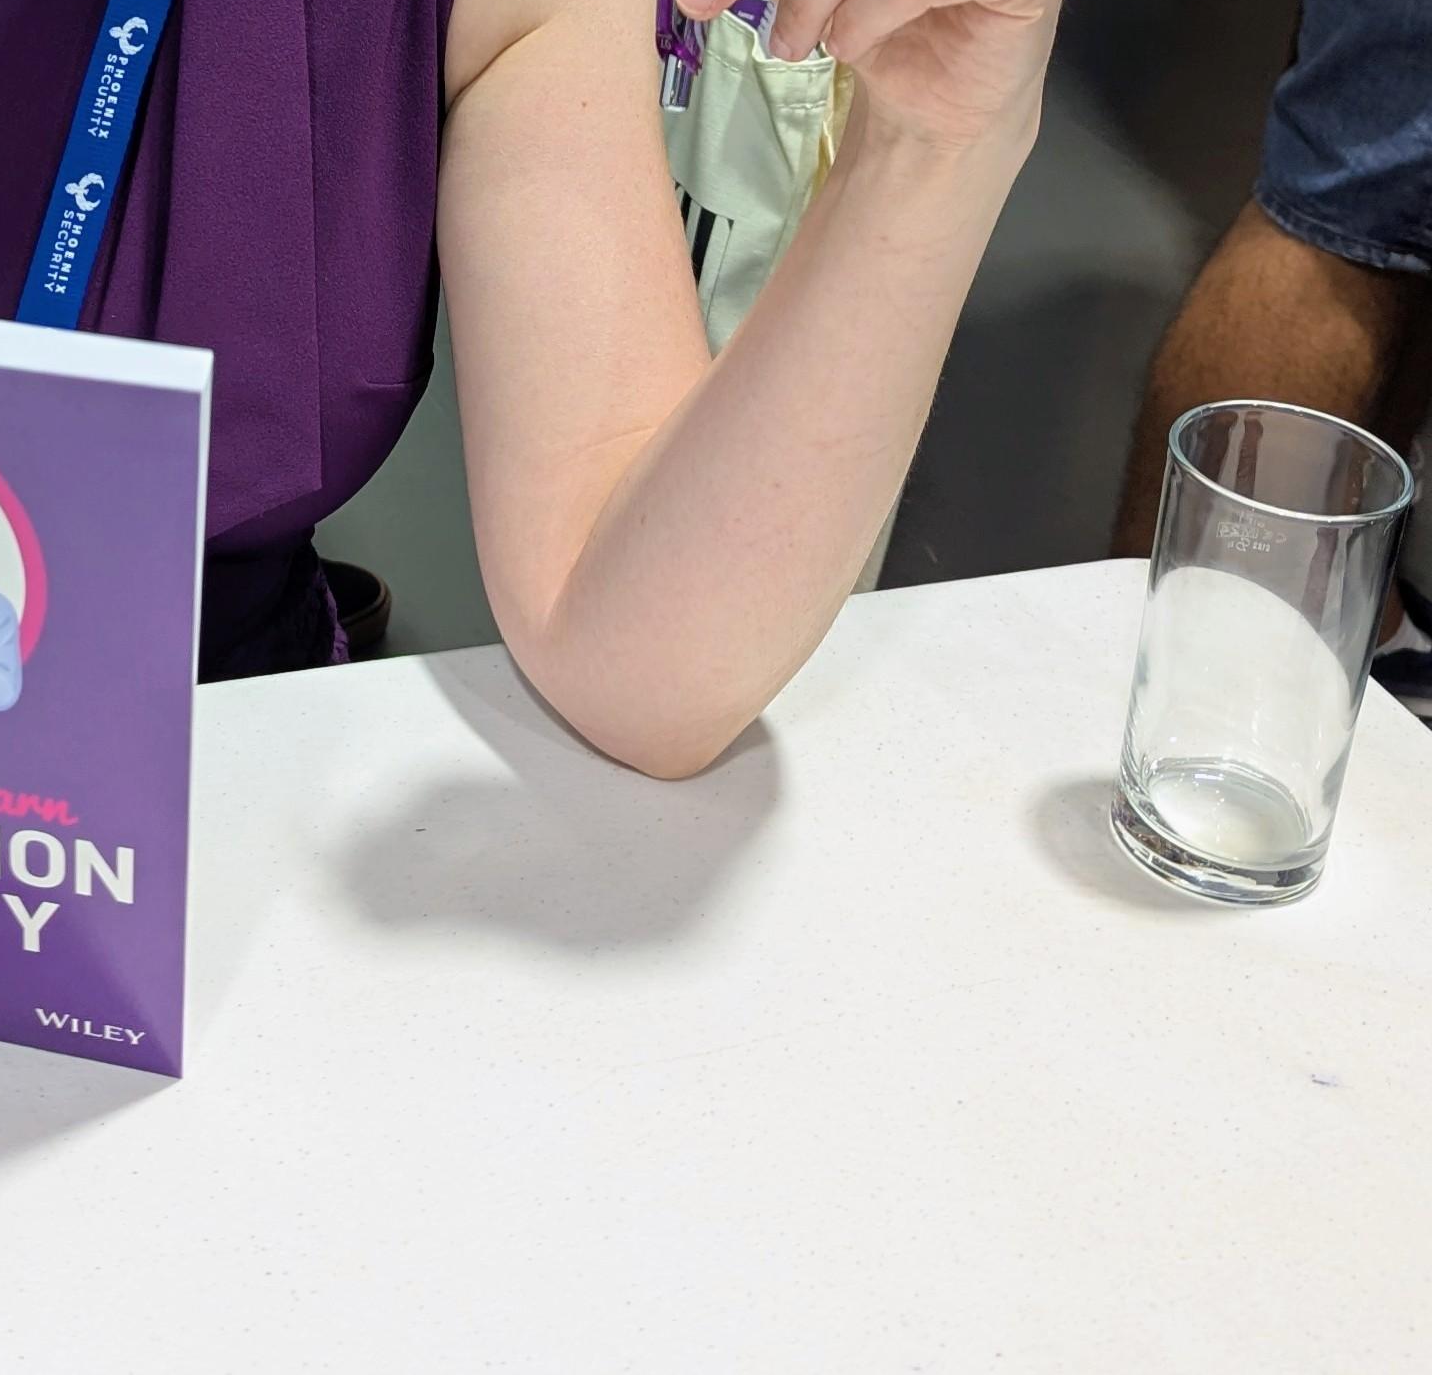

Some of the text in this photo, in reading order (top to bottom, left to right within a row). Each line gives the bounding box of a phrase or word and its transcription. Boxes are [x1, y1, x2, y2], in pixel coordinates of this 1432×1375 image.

[87, 53, 119, 138] SECURITY
[97, 56, 129, 139] PHOENIX
[43, 209, 75, 293] SECURITY
[54, 212, 87, 294] PHOENIX
[34, 1007, 147, 1047] WILEY
